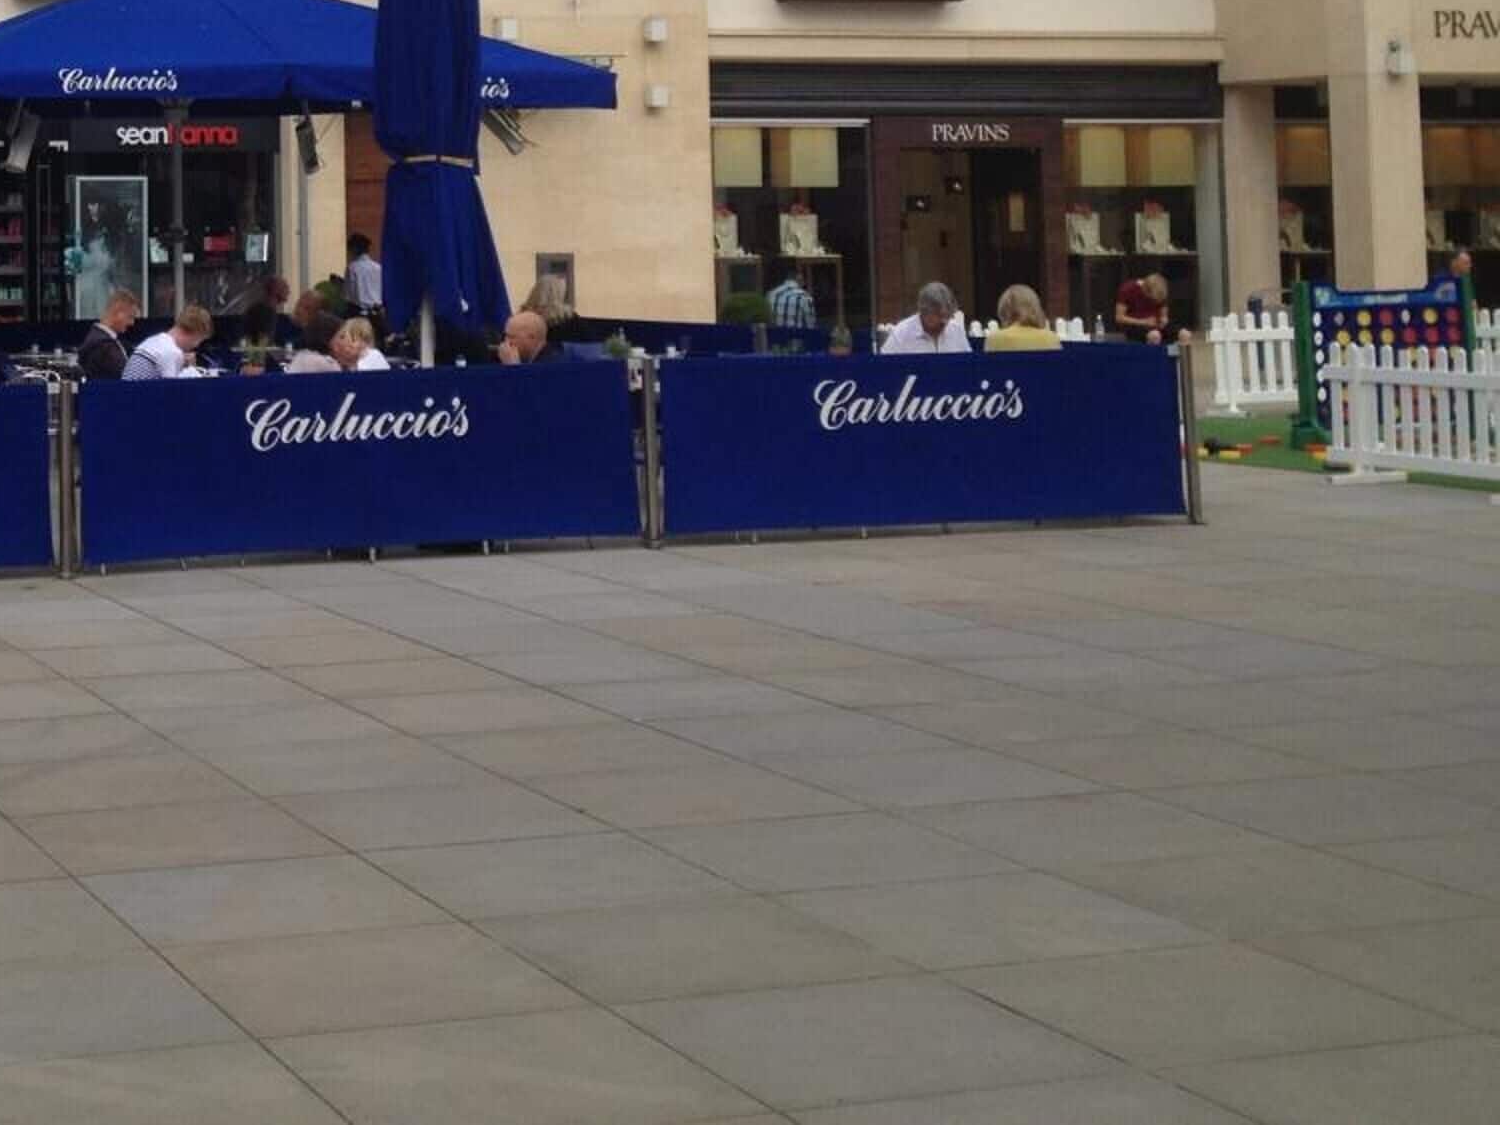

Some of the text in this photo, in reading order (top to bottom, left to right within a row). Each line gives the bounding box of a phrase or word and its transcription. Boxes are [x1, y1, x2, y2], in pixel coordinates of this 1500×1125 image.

[58, 66, 178, 94] Carluccio's
[931, 122, 1011, 142] PRAVINS
[245, 392, 469, 452] Carluccio's
[813, 374, 1024, 431] Carluccio's
